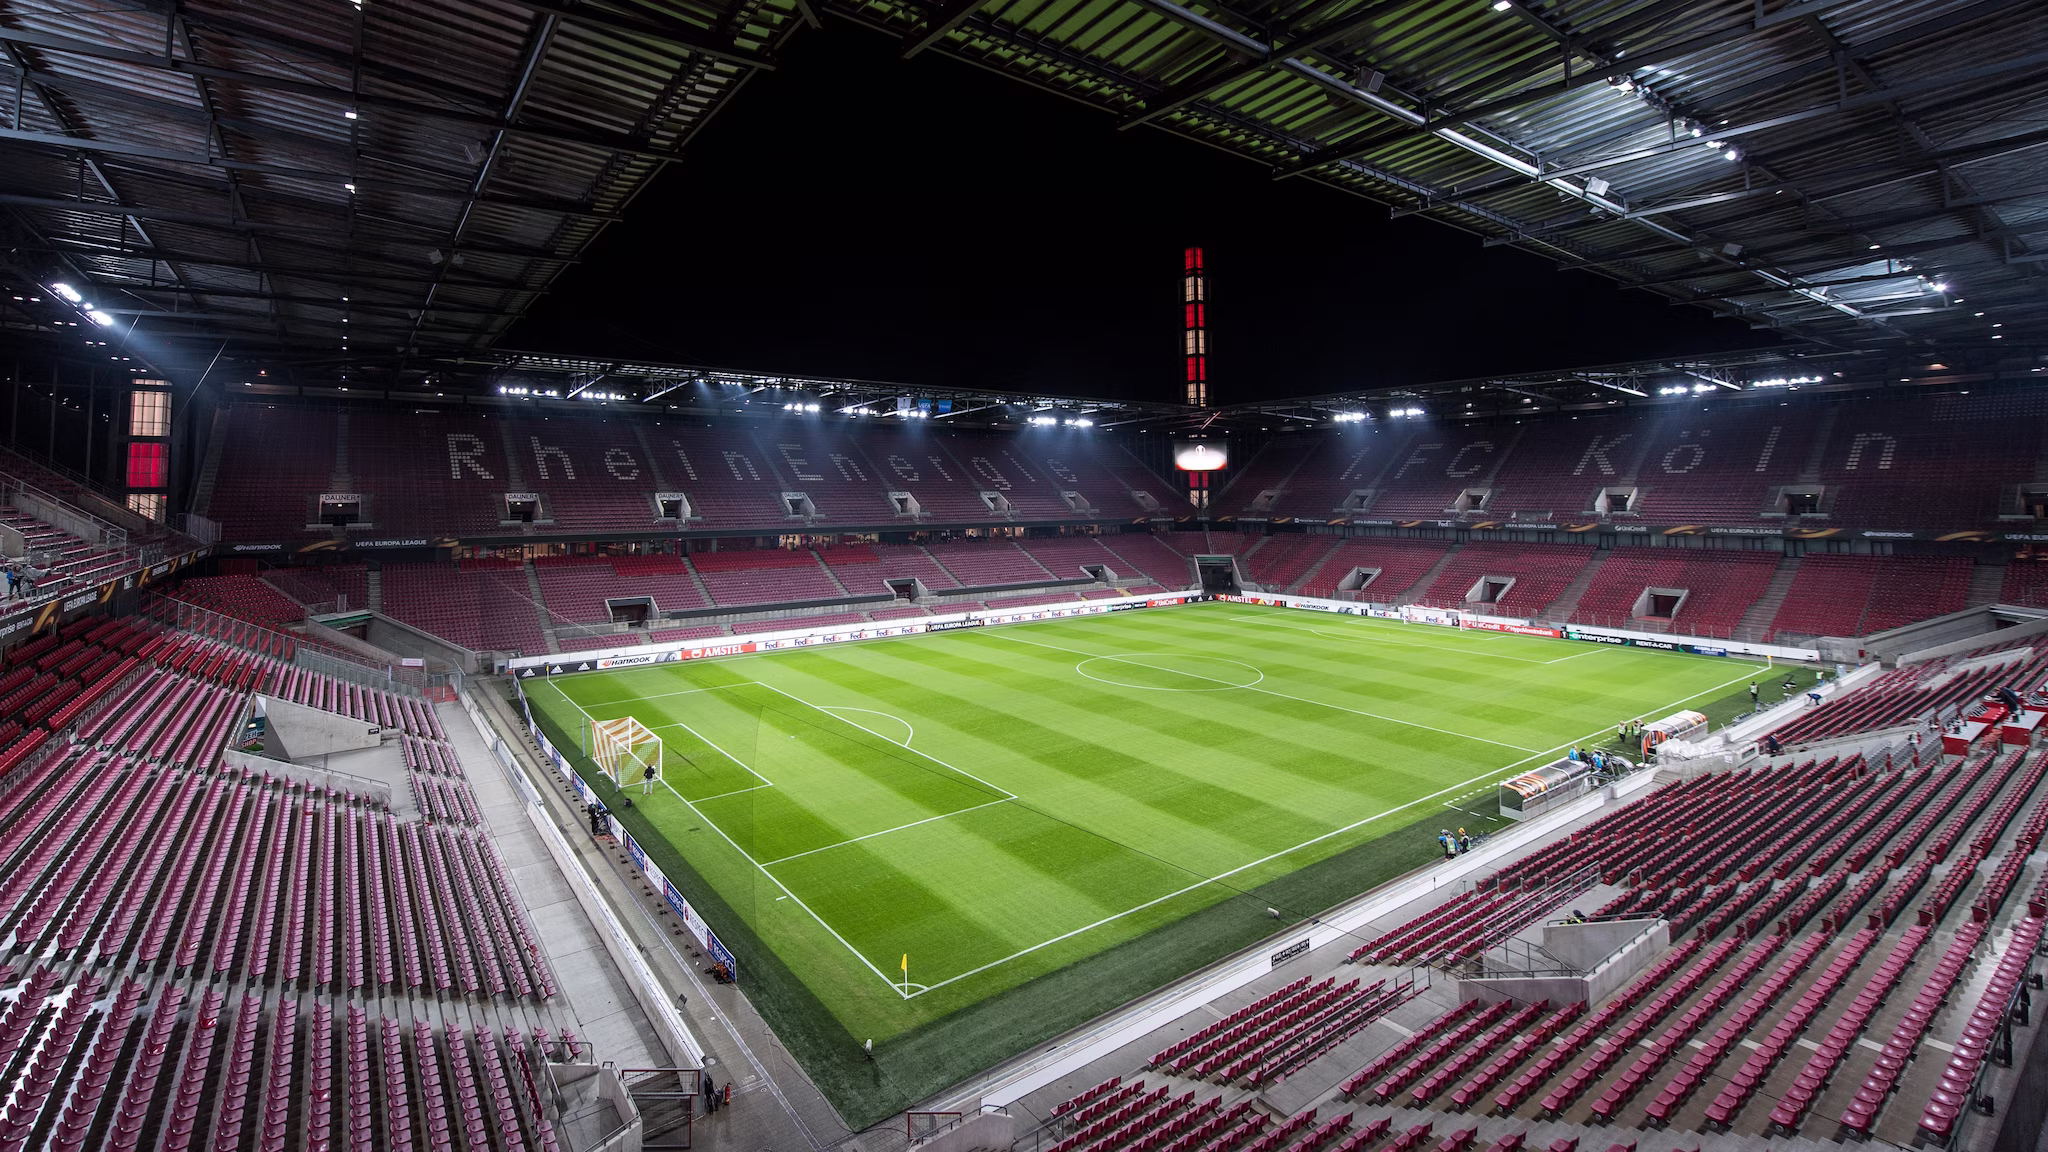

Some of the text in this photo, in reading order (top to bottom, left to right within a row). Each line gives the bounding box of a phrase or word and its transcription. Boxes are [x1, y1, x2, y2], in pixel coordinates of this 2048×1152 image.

[1572, 426, 1897, 475] Köln
[1394, 440, 1495, 478] FC
[1227, 594, 1253, 604] AMSTEL
[1071, 607, 1084, 615] FedEx
[1373, 610, 1392, 618] FedEx
[990, 616, 1006, 624] FedEx
[1425, 615, 1445, 625] FedEx
[876, 629, 894, 637] FedEx
[901, 626, 919, 634] FedEx
[822, 633, 842, 643] FedEx
[850, 631, 869, 640] FedEx
[1571, 631, 1622, 644] enterprise
[764, 641, 785, 650] FedEx
[794, 637, 814, 647] FedEx
[1635, 640, 1673, 650] RENT-A-CAR
[703, 644, 744, 658] AMSTEL
[241, 738, 257, 749] SHOP
